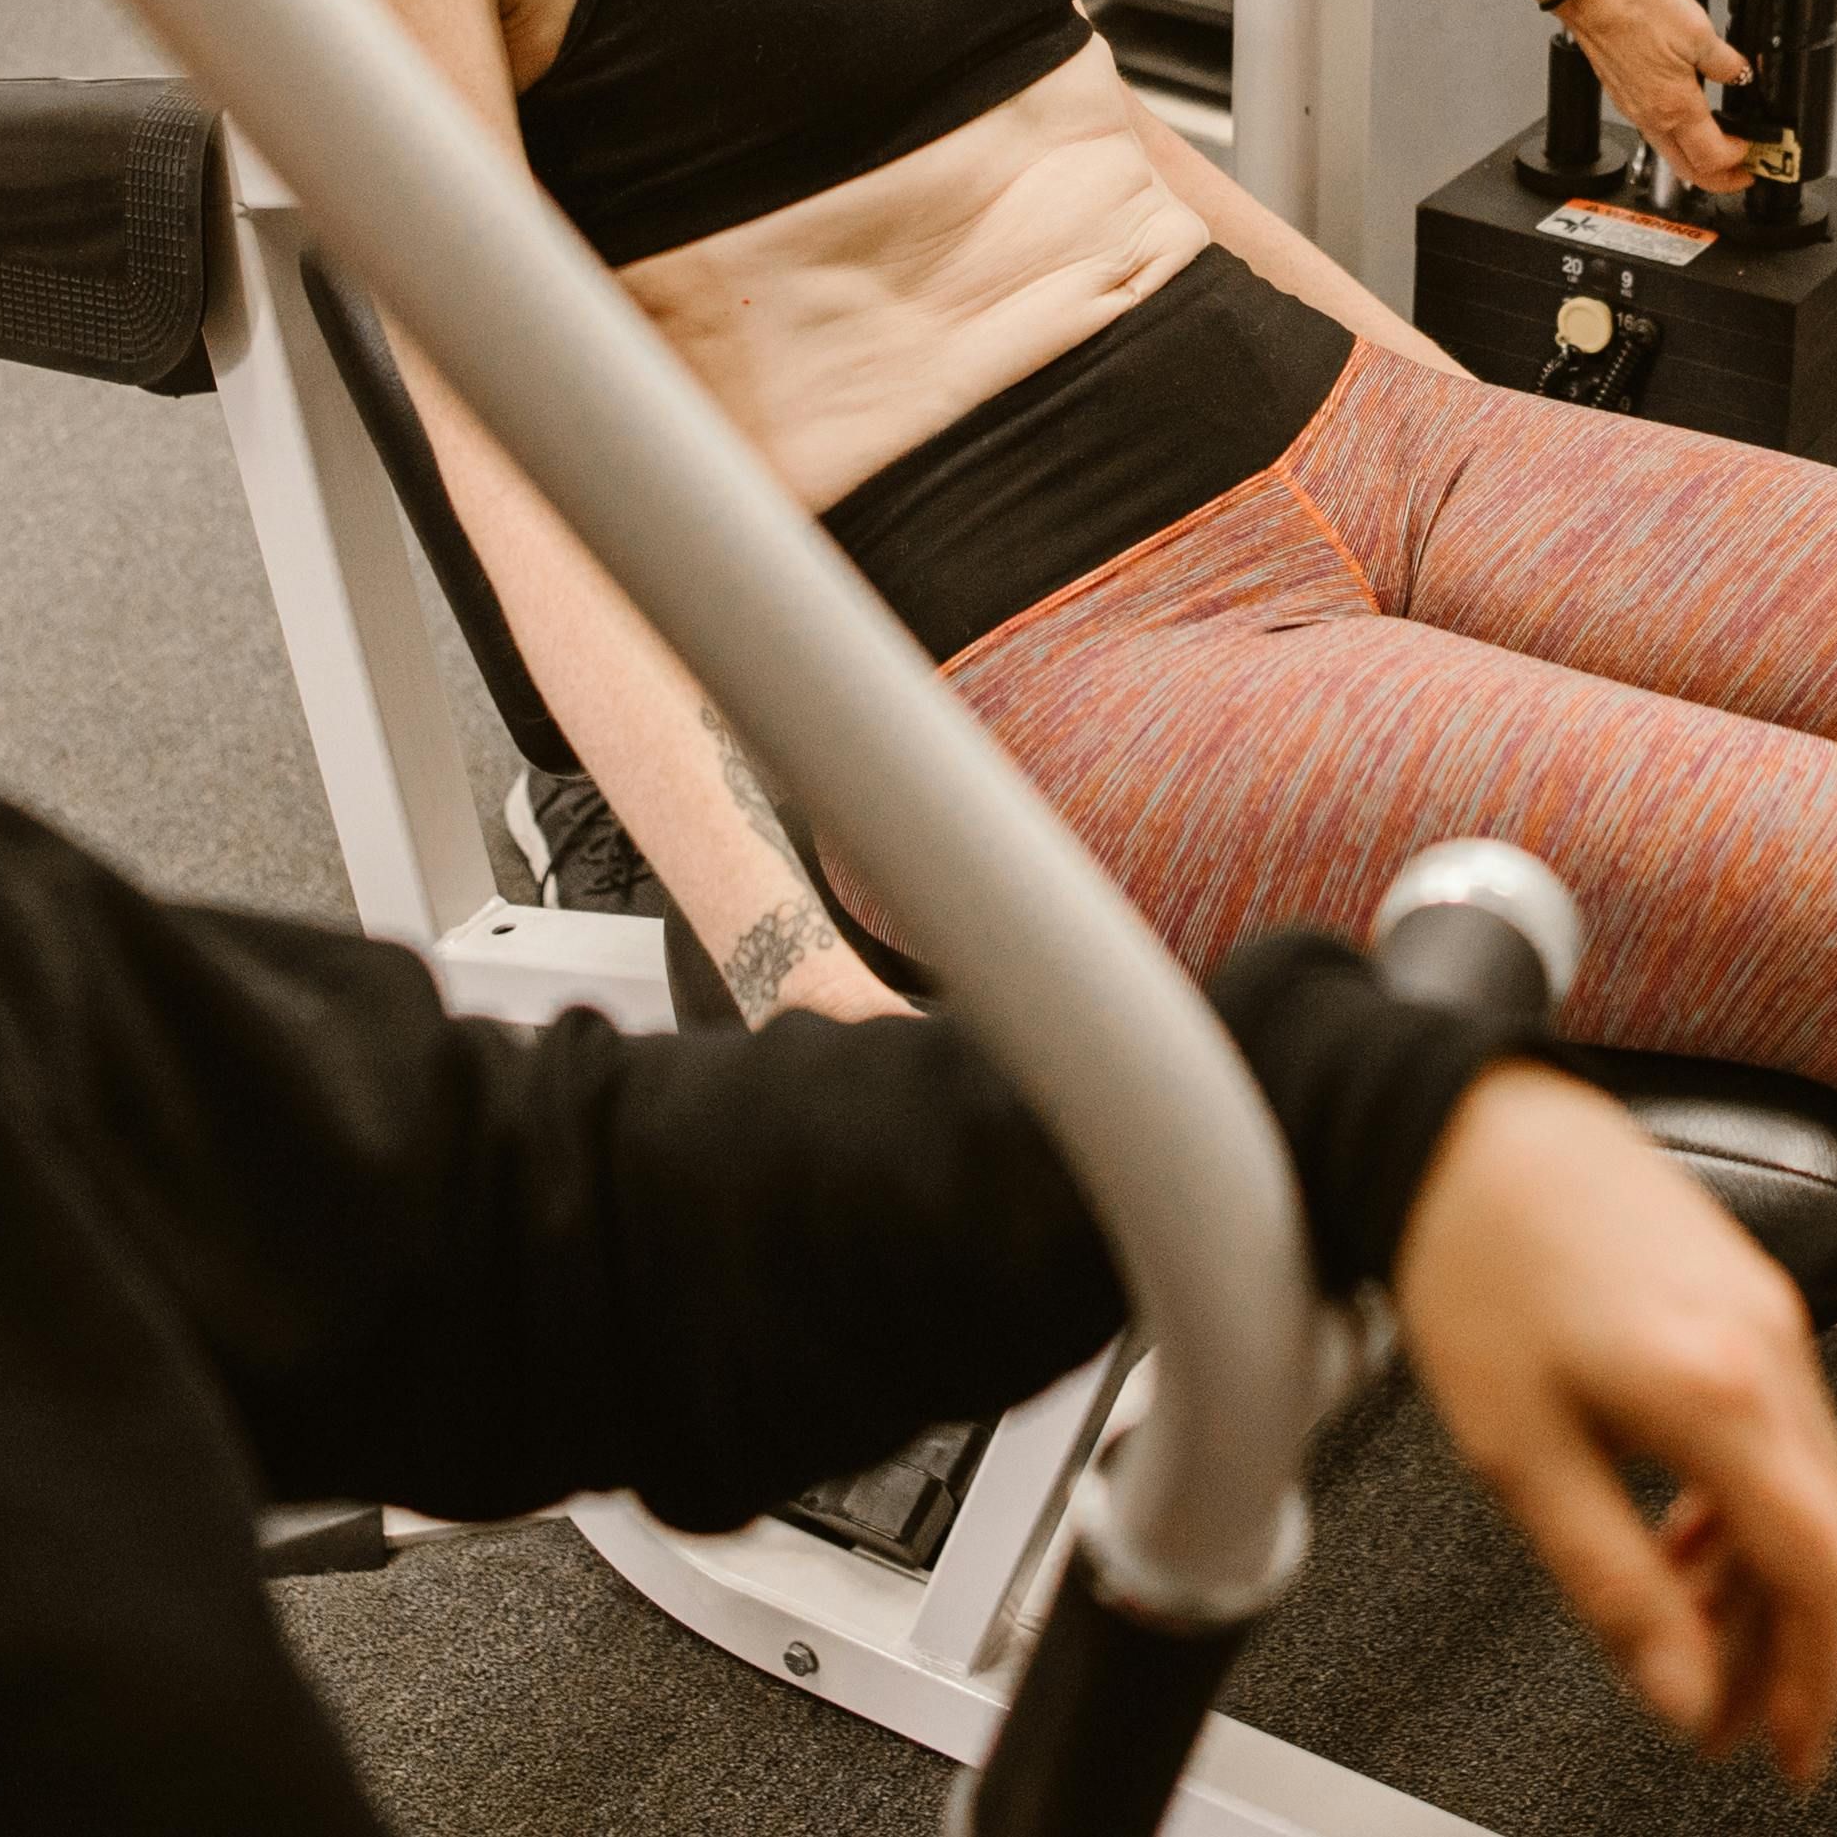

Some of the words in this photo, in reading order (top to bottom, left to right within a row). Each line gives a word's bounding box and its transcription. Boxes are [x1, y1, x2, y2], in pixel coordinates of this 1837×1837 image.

[1562, 256, 1583, 275] 20
[1621, 271, 1633, 288] 9
[1617, 313, 1634, 331] 16
